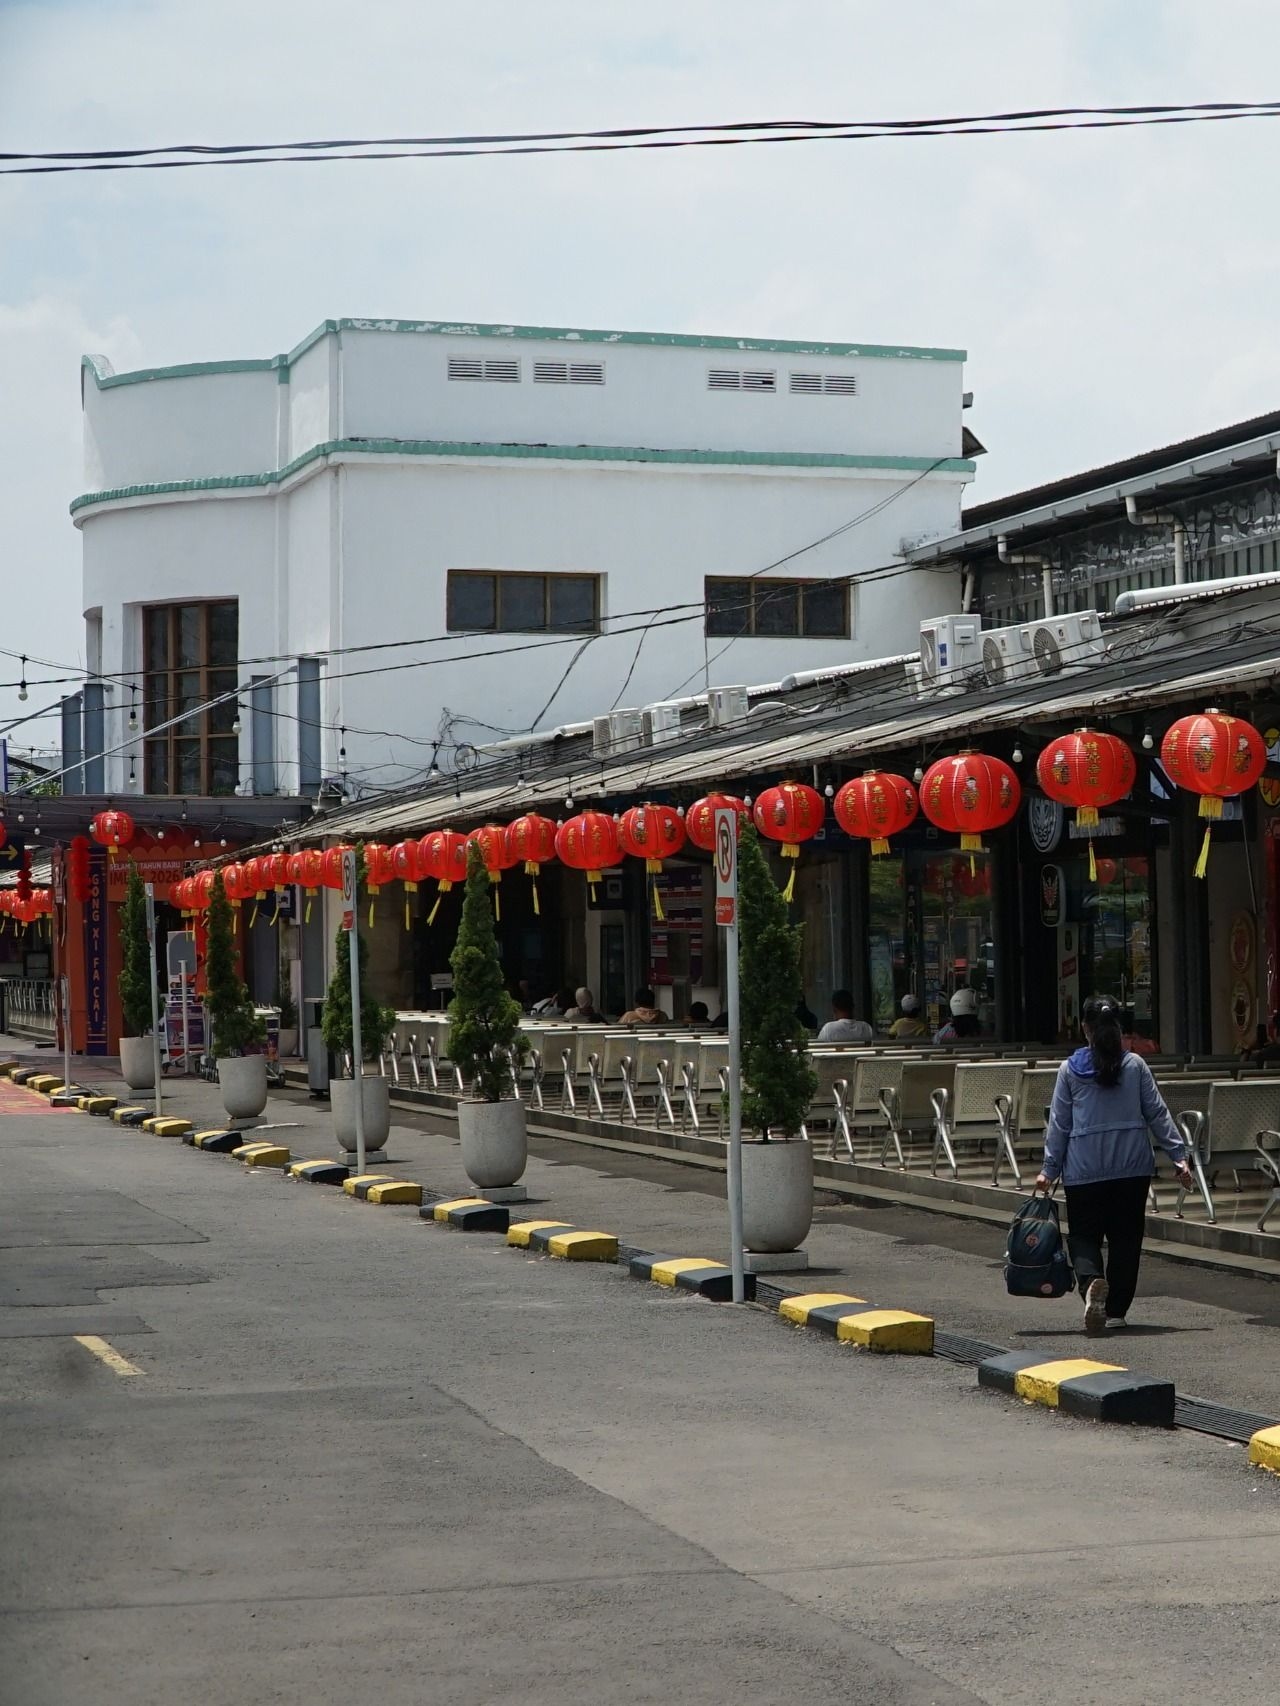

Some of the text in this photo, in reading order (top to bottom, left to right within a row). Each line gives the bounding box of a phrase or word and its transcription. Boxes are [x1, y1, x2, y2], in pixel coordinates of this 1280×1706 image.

[151, 869, 179, 884] 2026
[91, 873, 100, 1023] GONG XI FA CAI
